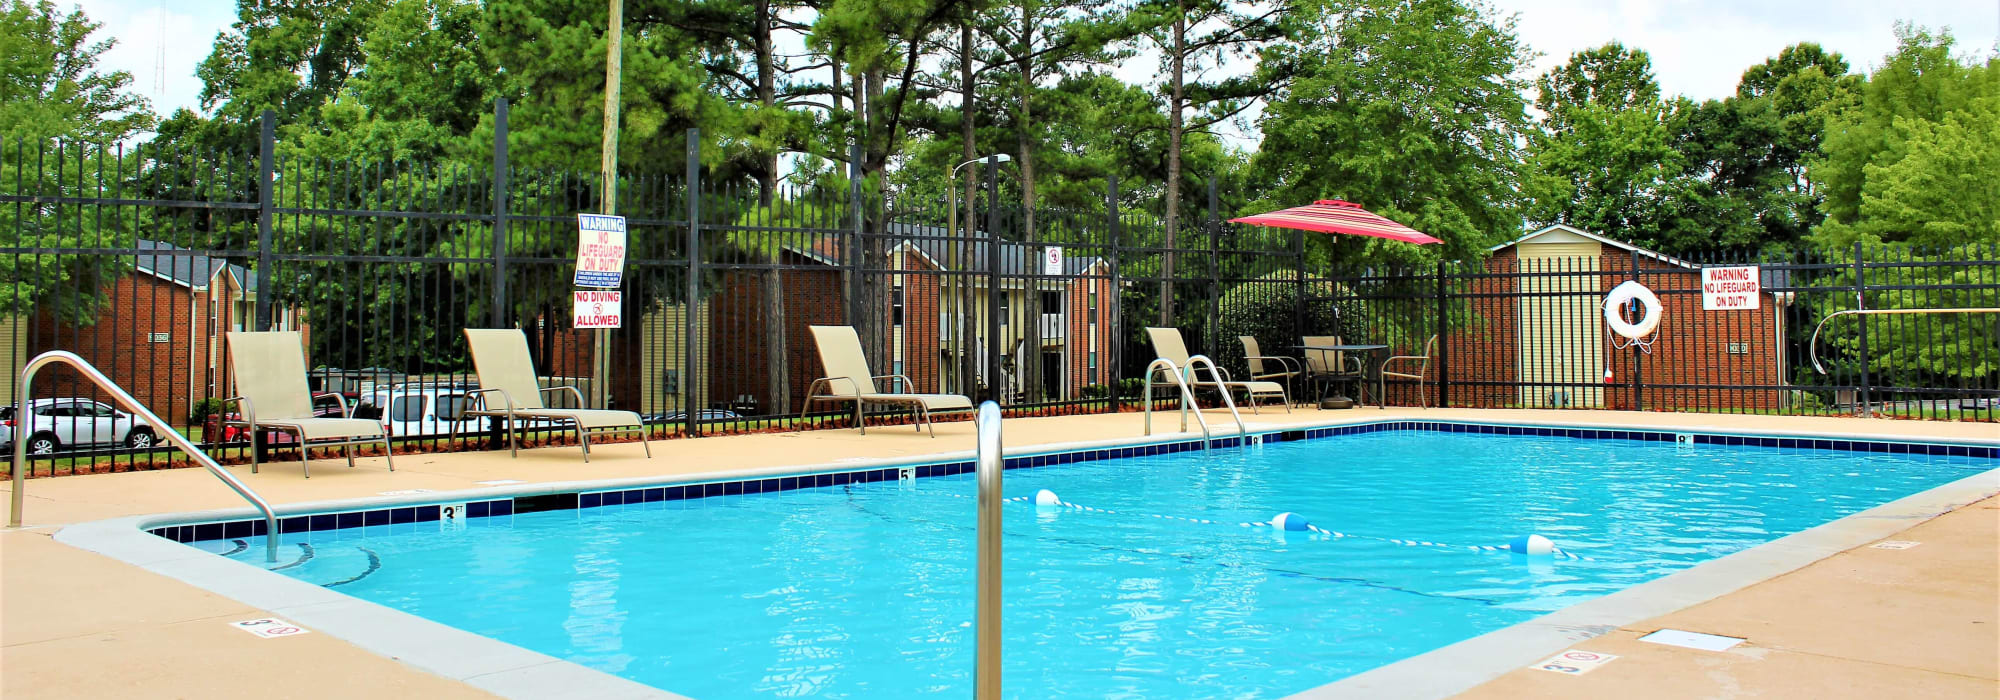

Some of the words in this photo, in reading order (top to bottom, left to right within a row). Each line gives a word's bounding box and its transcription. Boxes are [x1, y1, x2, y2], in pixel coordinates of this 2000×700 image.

[581, 217, 623, 231] WARNING
[598, 232, 608, 244] NO
[581, 244, 623, 258] LIFEGUARD
[585, 258, 596, 271] ON
[599, 259, 619, 271] DUTY
[1710, 268, 1749, 281] WARNING
[1704, 283, 1714, 293] NO
[1716, 282, 1756, 293] LIFEGUARD
[576, 292, 589, 302] NO
[591, 292, 620, 302] DIVING
[1716, 296, 1727, 307] ON
[1728, 296, 1747, 307] DUTY
[576, 315, 619, 327] ALLOWED
[901, 470, 909, 480] 5
[443, 507, 454, 519] 3
